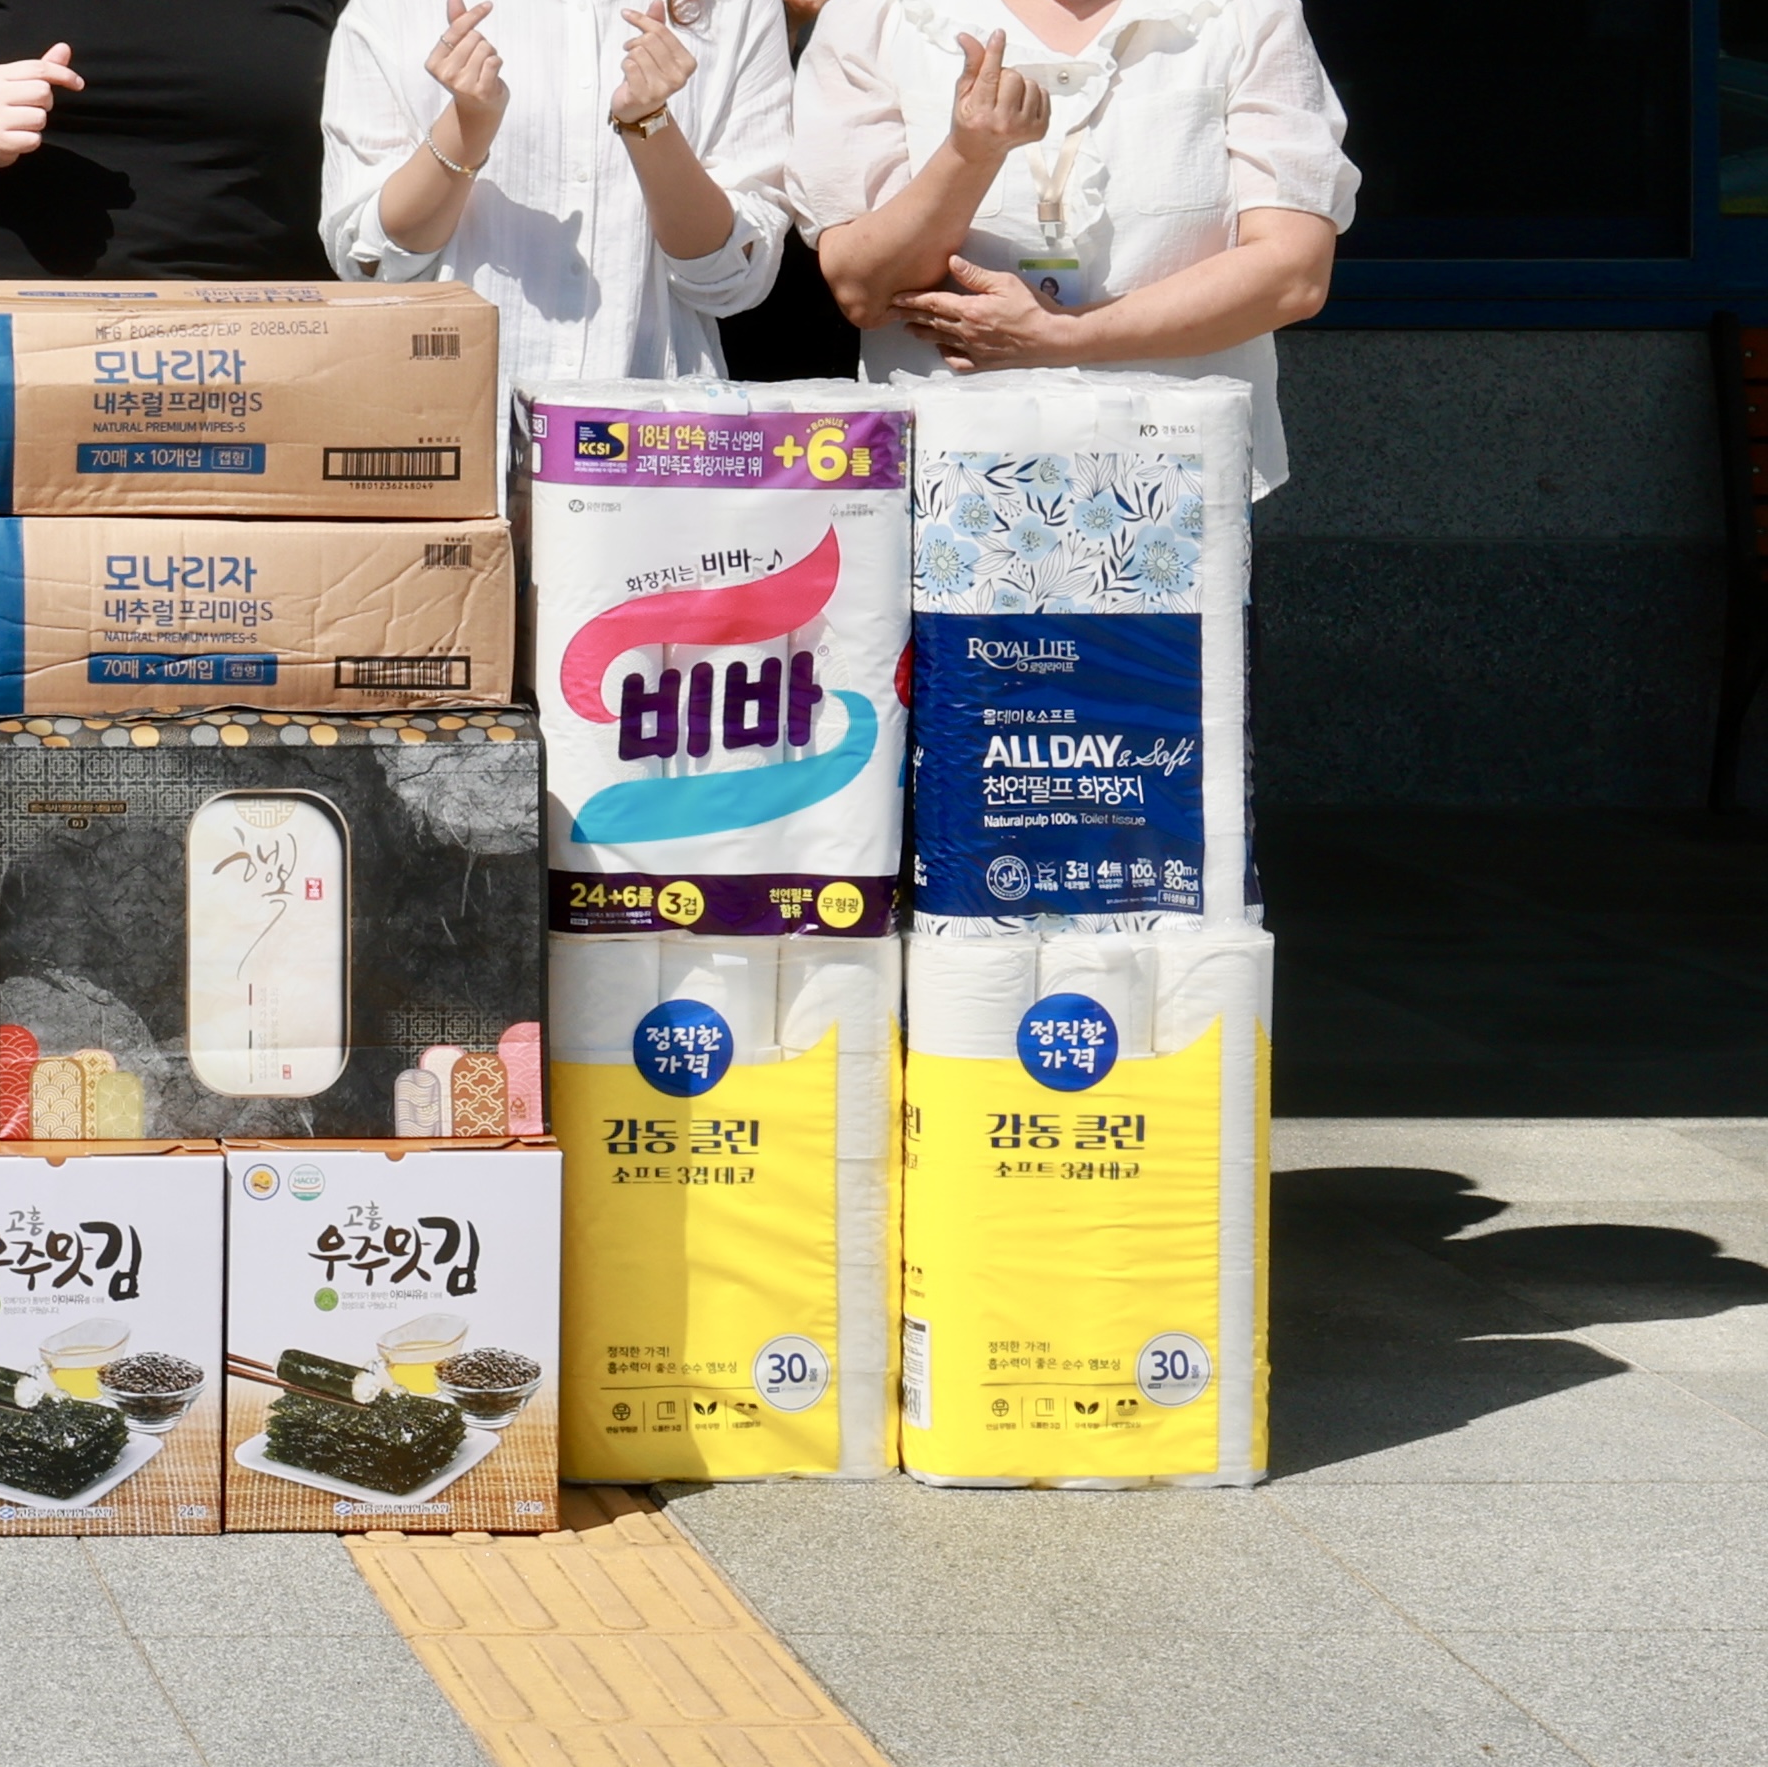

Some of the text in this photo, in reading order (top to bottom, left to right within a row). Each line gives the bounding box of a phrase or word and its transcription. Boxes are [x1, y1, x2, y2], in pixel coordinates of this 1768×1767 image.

[95, 326, 121, 339] MFG
[251, 321, 328, 336] 2028.05.21
[94, 349, 246, 385] 모나리자
[94, 391, 263, 417] 내추럴 프리미엄S
[93, 421, 245, 432] NATURAL PREMIUM WIPES-S
[811, 418, 844, 430] BONUS
[578, 443, 610, 456] KCSI
[637, 425, 764, 451] 18년 연속 한국 산업의
[90, 449, 127, 467] 70매
[150, 448, 202, 467] 10개입
[635, 455, 659, 476] 고객
[660, 455, 691, 476] 만족도
[693, 455, 745, 477] 화장지부문
[747, 455, 763, 477] 1위
[104, 555, 257, 592] 모나리자
[627, 565, 694, 593] 화장지는
[105, 599, 273, 627] 내추럴 프리미엄S
[967, 638, 1076, 666] ROYAL LIFE
[102, 659, 213, 679] 70매 10개입
[1029, 662, 1074, 673] 로얄라이프
[619, 650, 823, 761] 비바
[983, 709, 1076, 725] 올데이&소프트
[1131, 737, 1195, 776] Soft
[983, 775, 1144, 805] 천연펄프 화장지
[984, 812, 1146, 828] Natural pulp 100% Toilet tissue
[1066, 860, 1089, 879] 3겹
[570, 882, 697, 915] 24+6롤 3겹
[769, 888, 813, 904] 천연펄프
[823, 897, 859, 913] 무형광
[781, 904, 802, 919] 함유
[646, 1024, 722, 1052] 정직한
[1030, 1018, 1106, 1046] 정직한
[654, 1053, 710, 1079] 가격
[1038, 1047, 1095, 1073] 가격
[602, 1119, 760, 1154] 감동 클린
[986, 1113, 1145, 1150] 감동 클린
[612, 1167, 755, 1185] 소프트 3겹 데코
[993, 1161, 1140, 1180] 소프트 3겹 데코
[309, 1217, 479, 1294] 우주맛김
[645, 1346, 670, 1358] 가격!
